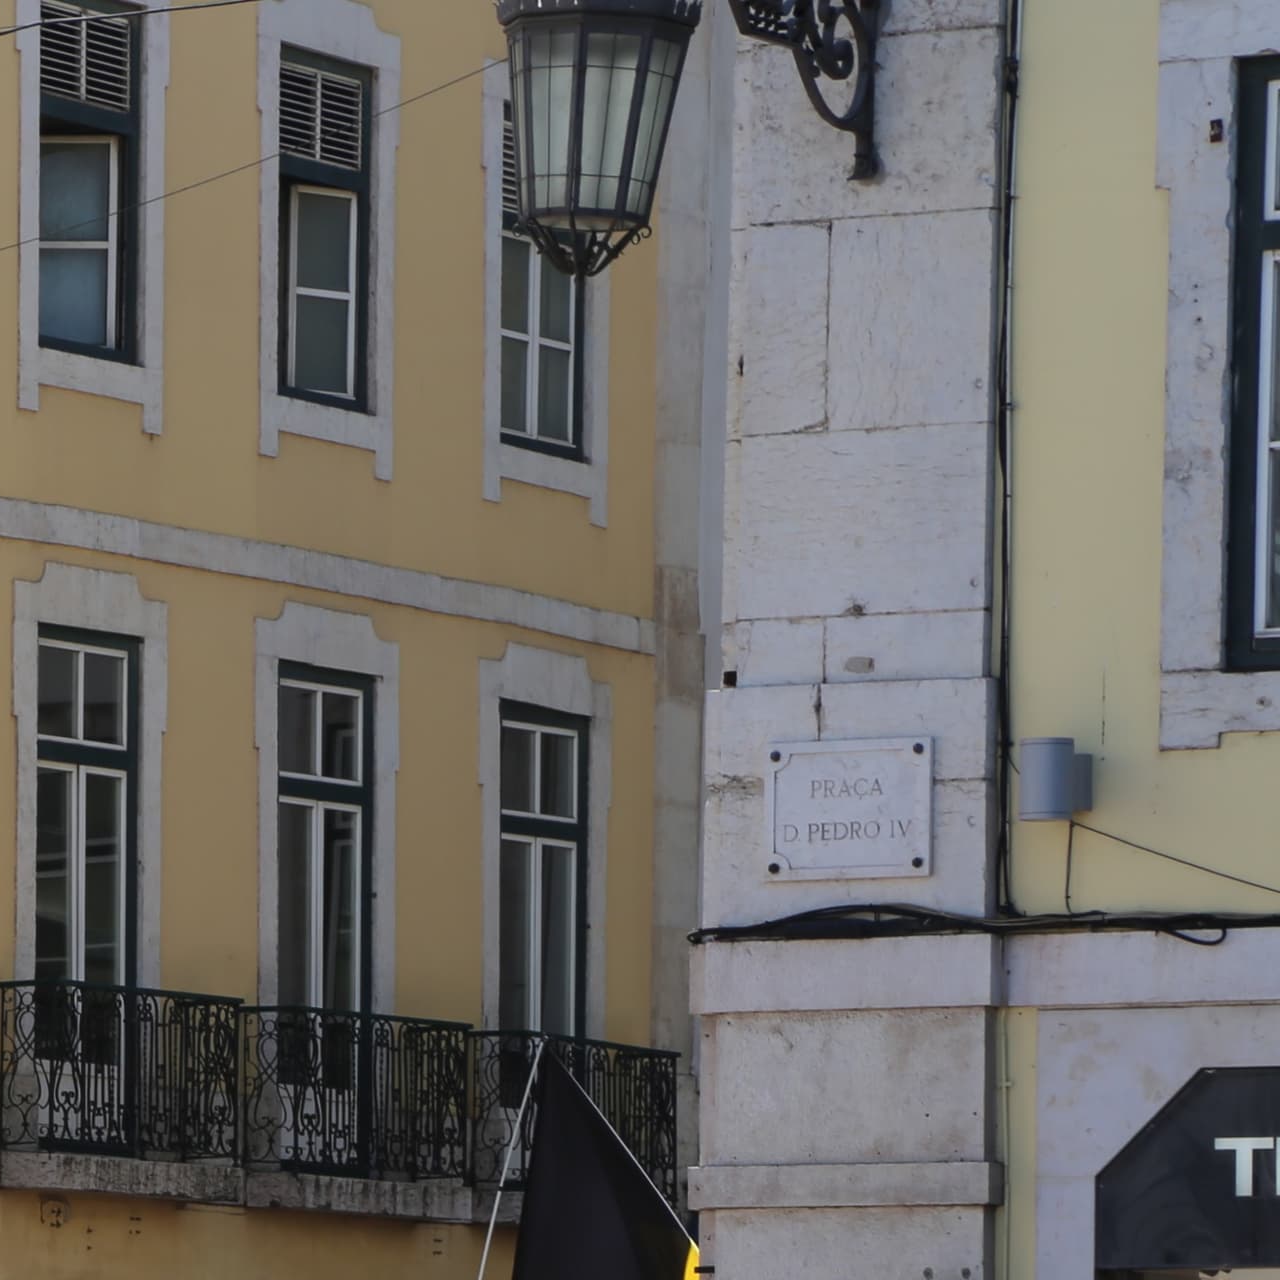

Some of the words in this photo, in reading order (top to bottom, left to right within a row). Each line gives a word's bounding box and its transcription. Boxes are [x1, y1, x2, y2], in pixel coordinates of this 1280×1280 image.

[810, 778, 883, 800] PRAÇA
[783, 824, 801, 843] D.
[808, 820, 881, 842] PEDRO
[890, 819, 913, 839] IV
